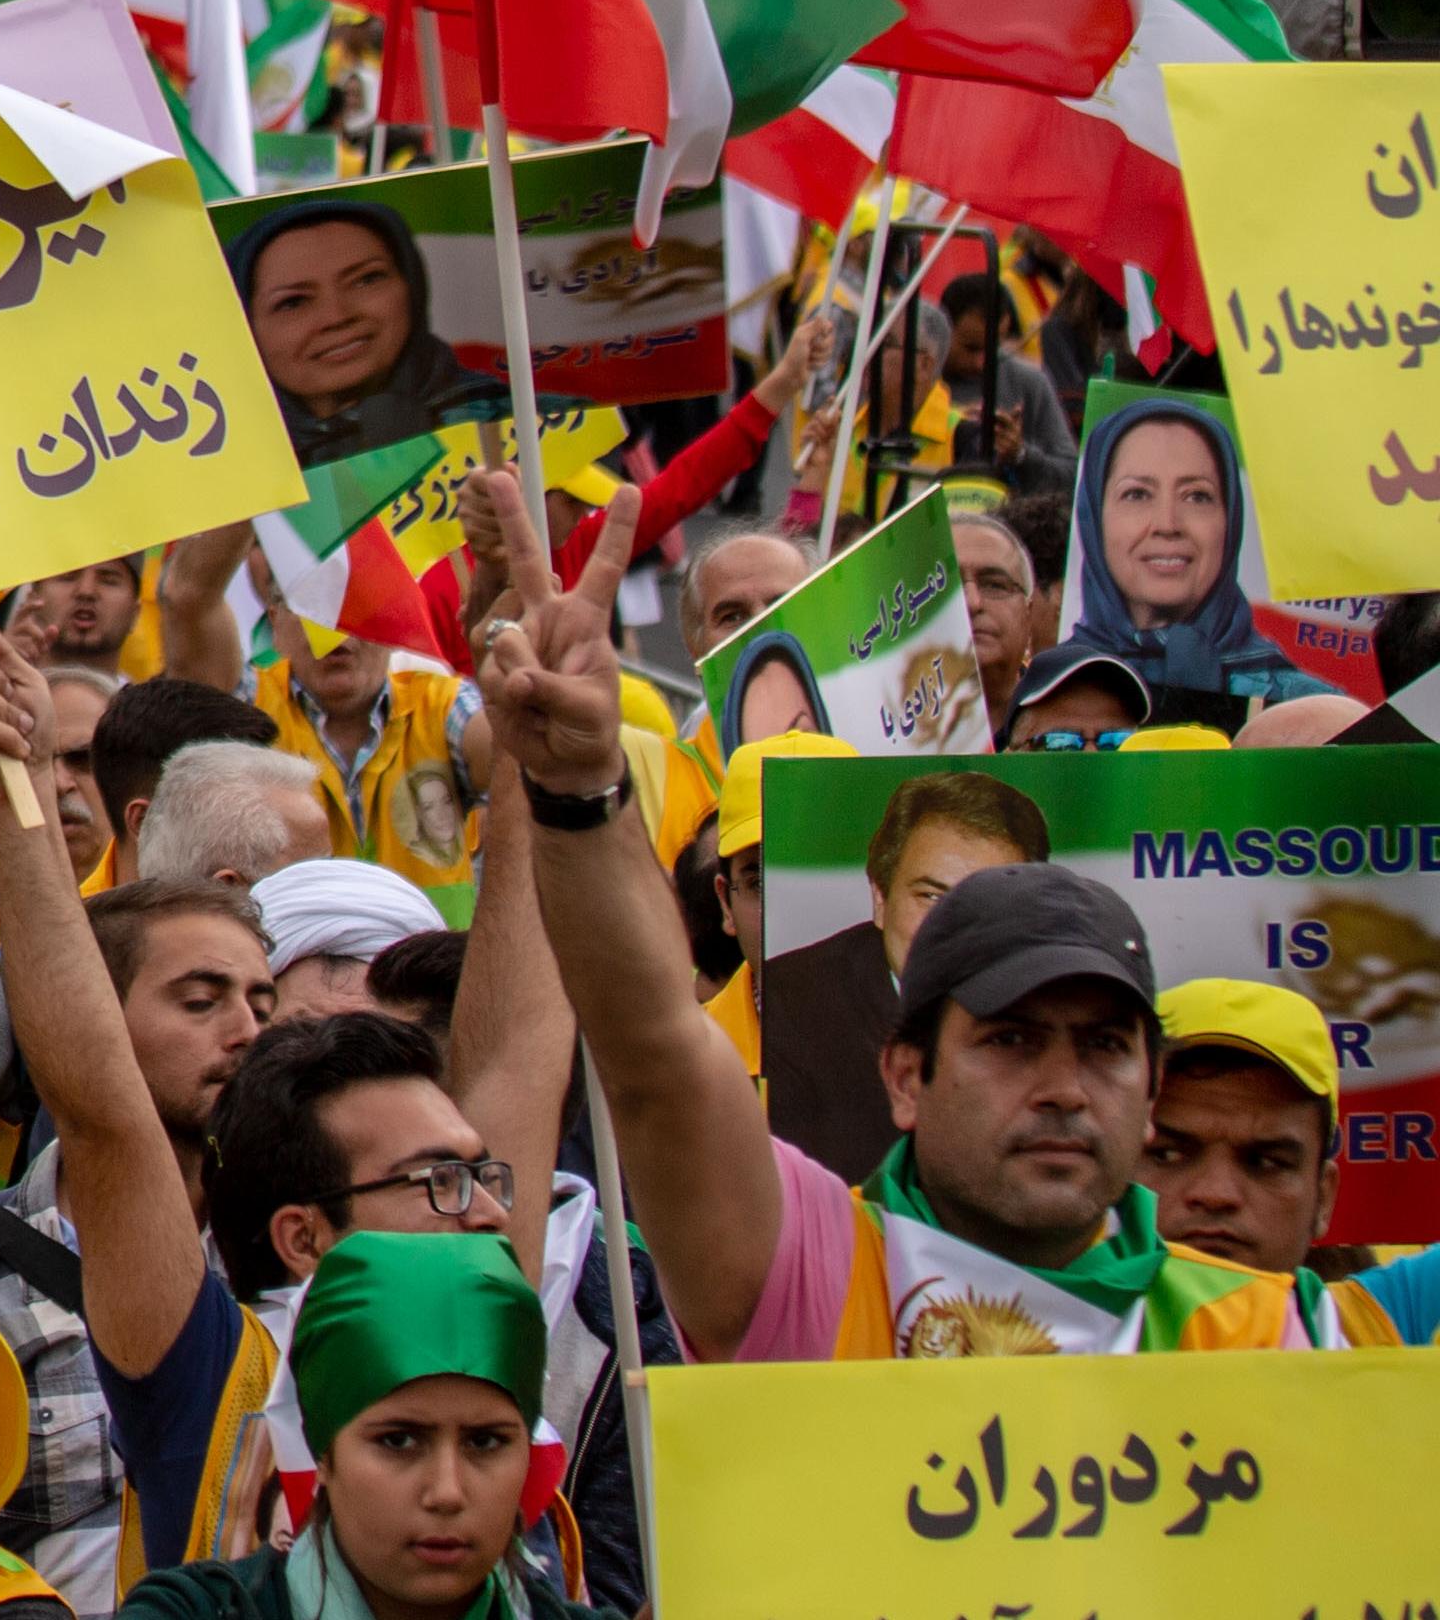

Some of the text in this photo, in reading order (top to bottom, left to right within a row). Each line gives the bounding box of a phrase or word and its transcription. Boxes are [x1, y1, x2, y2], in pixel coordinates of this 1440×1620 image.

[16, 351, 228, 499] زندان
[1296, 621, 1370, 658] Raja
[1266, 921, 1332, 970] IS
[905, 1413, 1264, 1541] مزدوران
